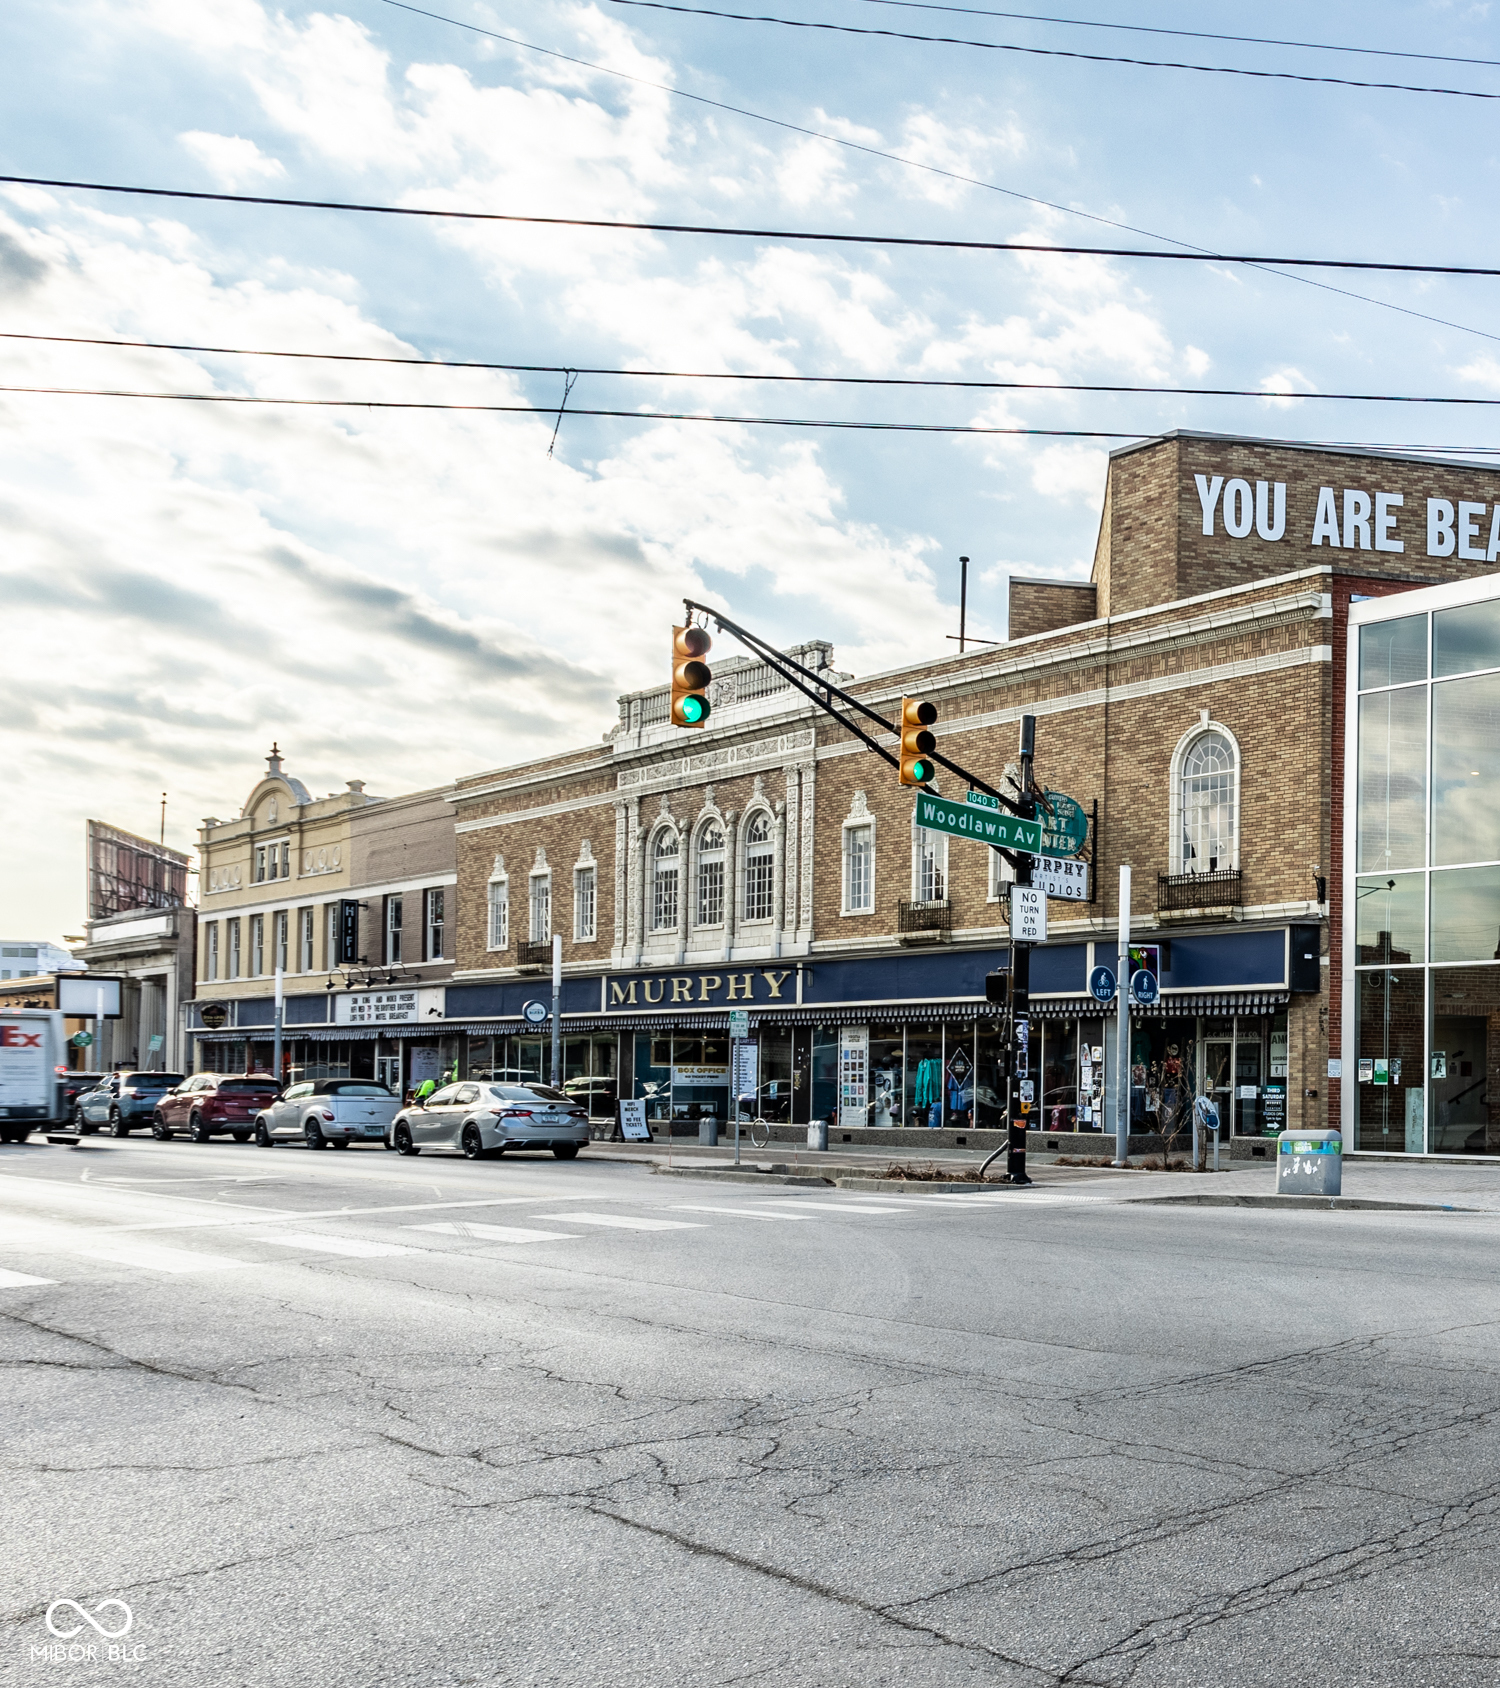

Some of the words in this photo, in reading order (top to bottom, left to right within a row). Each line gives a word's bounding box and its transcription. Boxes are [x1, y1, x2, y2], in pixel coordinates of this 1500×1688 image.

[1193, 474, 1287, 541] YOU
[1311, 486, 1405, 553] ARE
[968, 792, 988, 806] 1040
[991, 799, 997, 808] S
[923, 802, 1007, 839] Woodlawn
[1013, 826, 1036, 845] Av
[1037, 814, 1068, 832] ART
[1042, 832, 1077, 851] NTER
[1034, 857, 1085, 878] URPHY
[1022, 892, 1038, 903] NO
[1020, 904, 1040, 915] TURN
[1023, 915, 1035, 925] ON
[1022, 926, 1037, 936] RED
[609, 971, 792, 1005] MURPHY
[1096, 988, 1112, 997] LEFT
[1137, 991, 1154, 999] RIGHT
